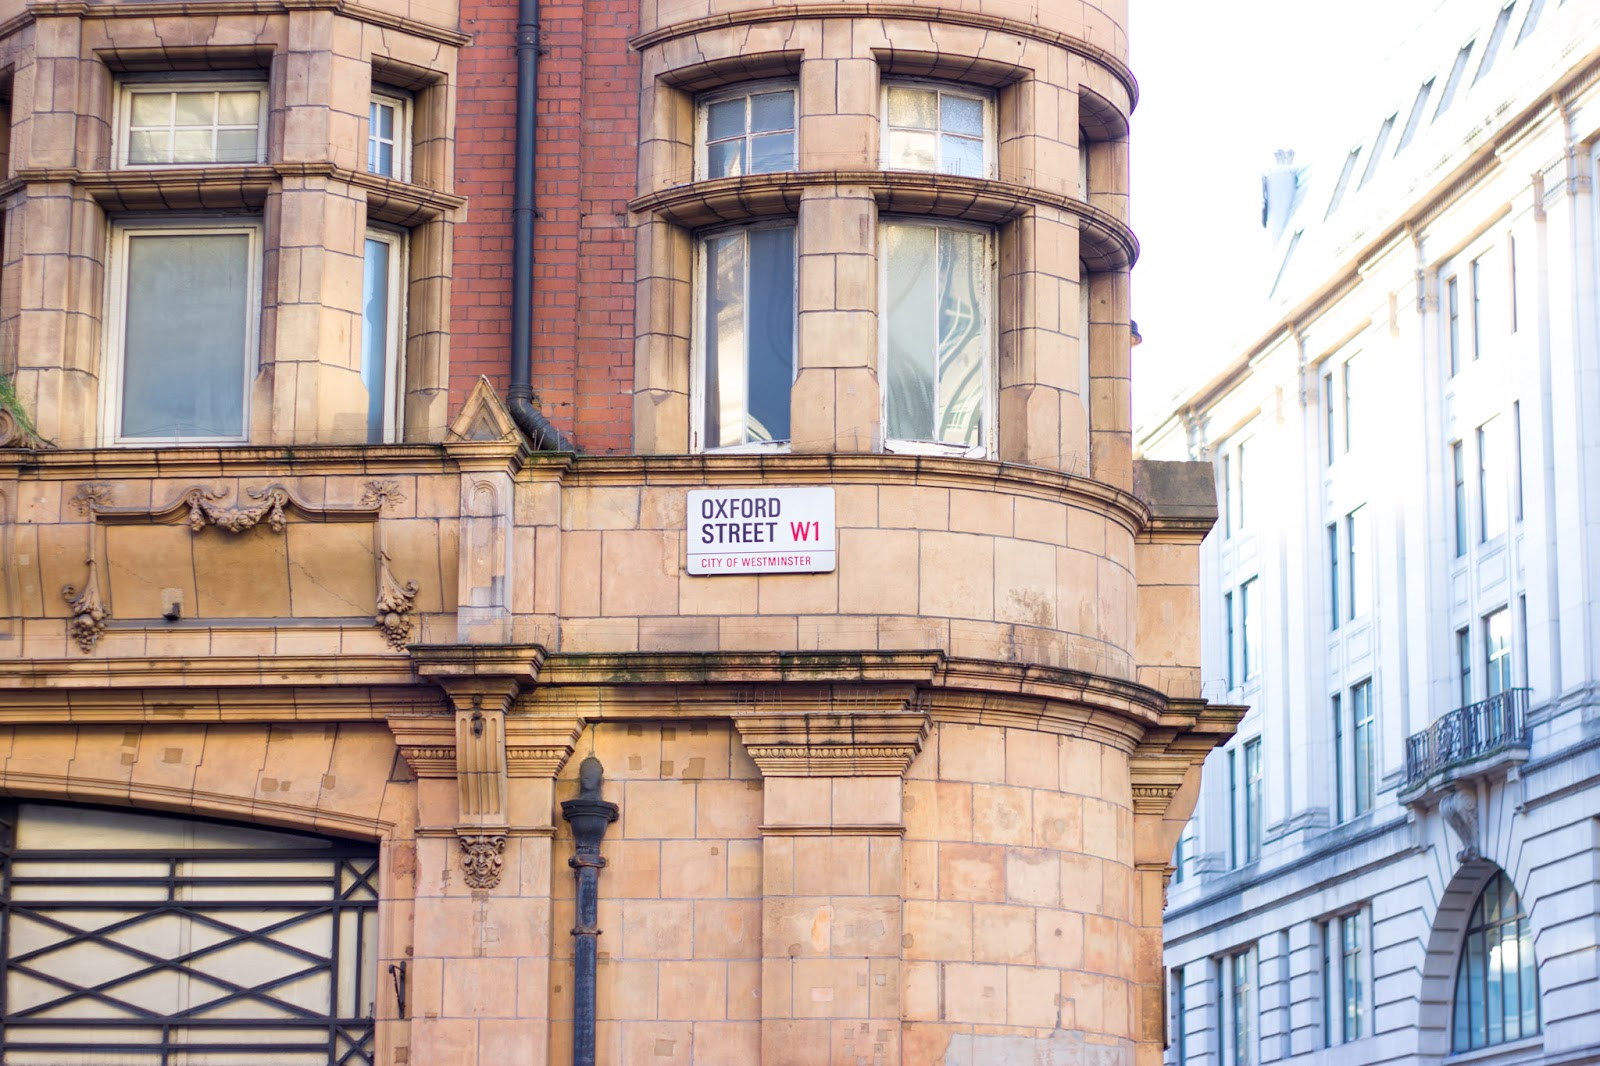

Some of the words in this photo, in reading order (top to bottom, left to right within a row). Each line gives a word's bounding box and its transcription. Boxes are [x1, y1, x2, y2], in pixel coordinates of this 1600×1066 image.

[701, 498, 781, 519] OXFORD
[701, 522, 778, 544] STREET
[789, 521, 819, 541] W1
[701, 558, 723, 568] CITY
[726, 557, 738, 568] OF
[741, 556, 811, 567] WESTMINSTER
